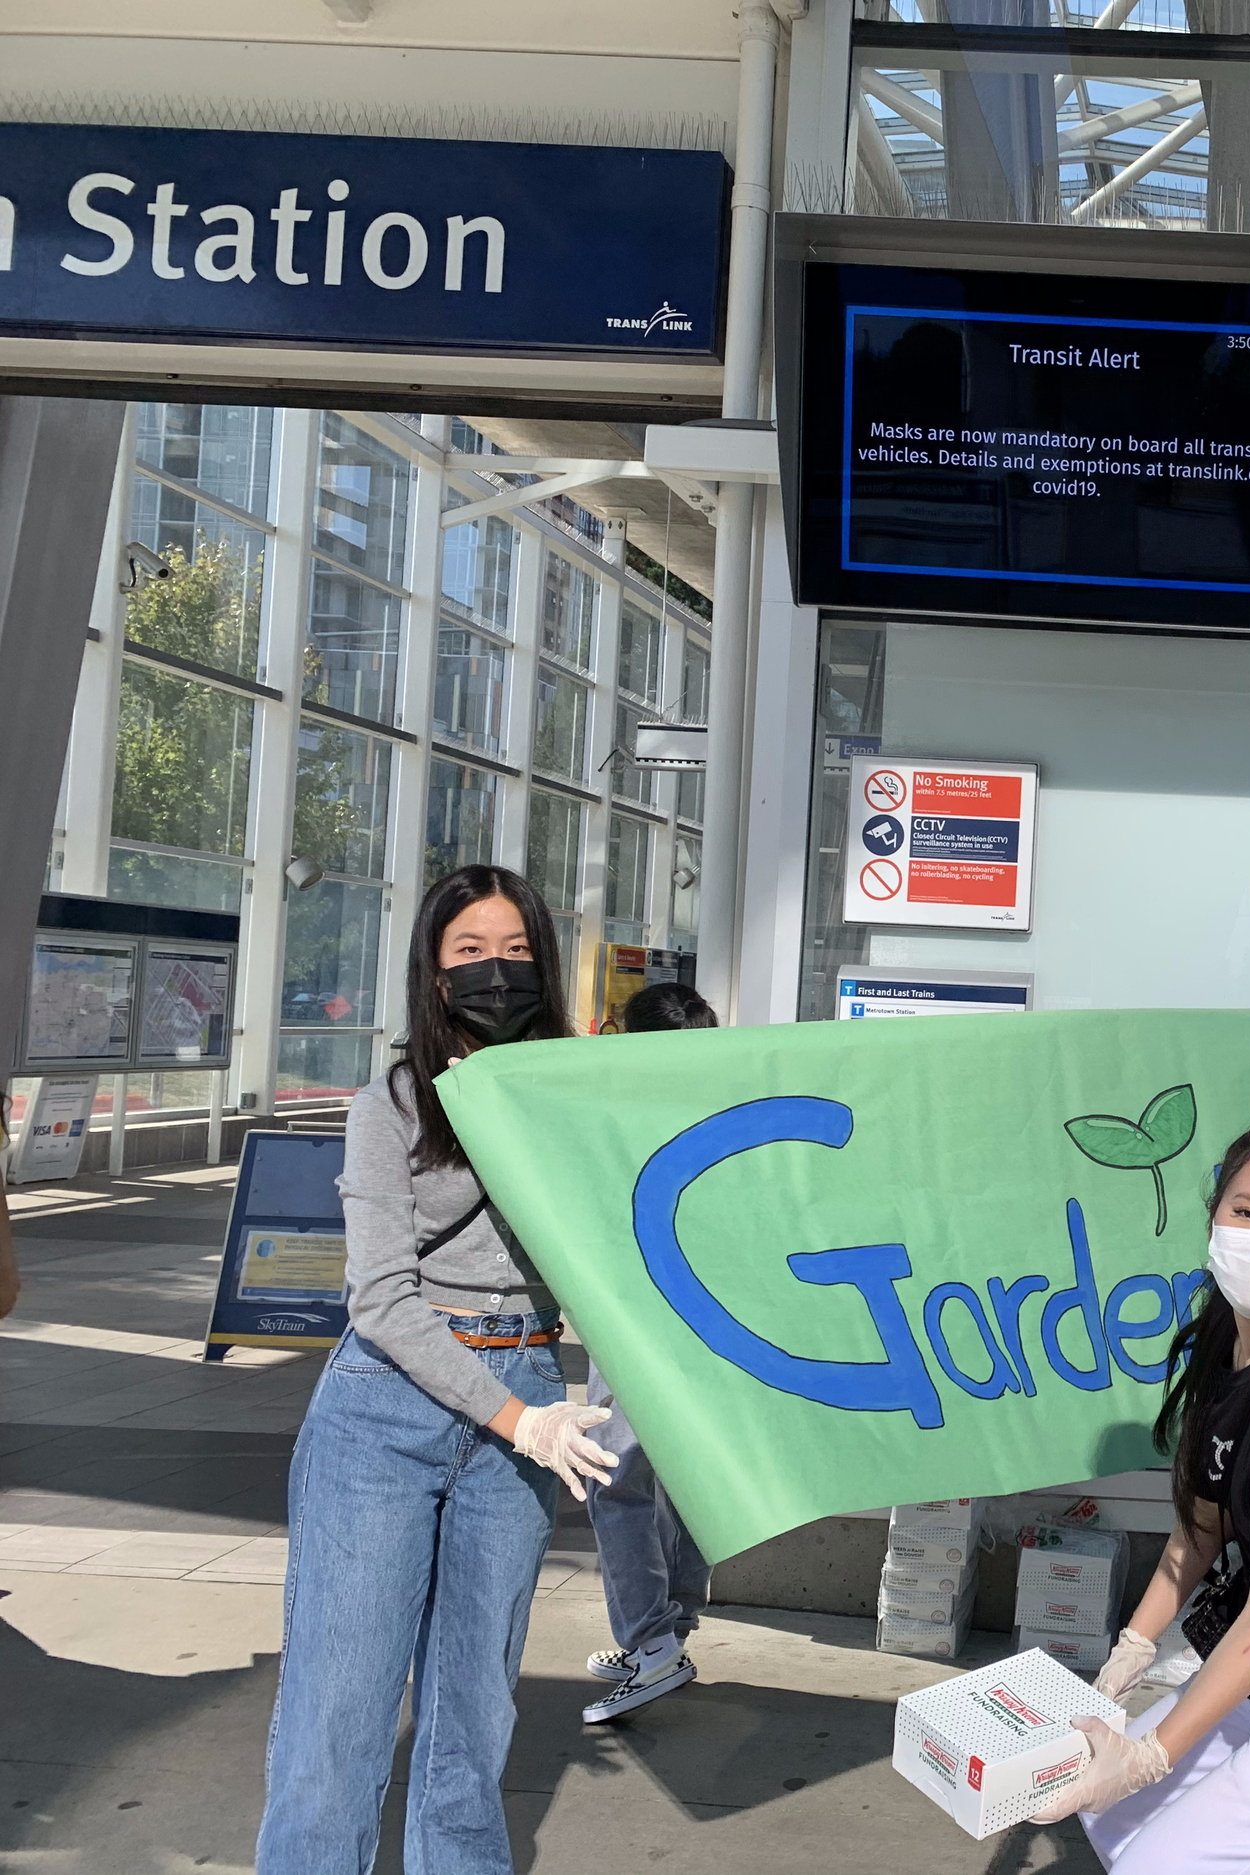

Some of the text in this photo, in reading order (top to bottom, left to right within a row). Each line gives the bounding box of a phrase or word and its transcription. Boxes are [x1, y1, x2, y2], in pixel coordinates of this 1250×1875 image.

[60, 171, 505, 293] Station
[606, 318, 692, 331] TRANS LINK
[1009, 344, 1140, 369] Transit Alert
[870, 422, 922, 440] Masks
[928, 428, 955, 442] are
[961, 430, 996, 444] now
[1002, 431, 1096, 452] mandatory
[1101, 437, 1122, 450] on
[1129, 435, 1178, 453] board
[1184, 439, 1205, 455] all
[858, 445, 932, 464] vehicles.
[938, 449, 997, 468] Details
[1003, 454, 1035, 470] and
[1041, 457, 1141, 476] exemptions
[1146, 462, 1163, 476] at
[1033, 478, 1100, 497] covid19.
[915, 775, 988, 791] No Smoking
[946, 790, 978, 798] metres/25
[914, 819, 945, 831] CCTV
[913, 832, 1008, 844] Closed Circuit Television (CCTV)
[913, 839, 949, 848] surveillance
[951, 841, 973, 851] system
[921, 863, 949, 872] loitering,
[960, 866, 1005, 875] skateboarding,
[920, 871, 961, 880] rollerblading,
[972, 874, 993, 882] cycling
[858, 987, 875, 996] First
[876, 988, 892, 997] and
[893, 988, 910, 998] Last
[911, 989, 935, 999] Trains
[33, 1125, 51, 1137] VISA
[257, 1318, 306, 1332] SkyTrain
[1048, 1575, 1081, 1584] FUNDRAISING
[967, 1691, 1028, 1737] FUNDRAISING
[918, 1751, 957, 1790] FUNDRAISING
[971, 1768, 980, 1783] 12
[1028, 1774, 1080, 1801] FUNDRAISING
